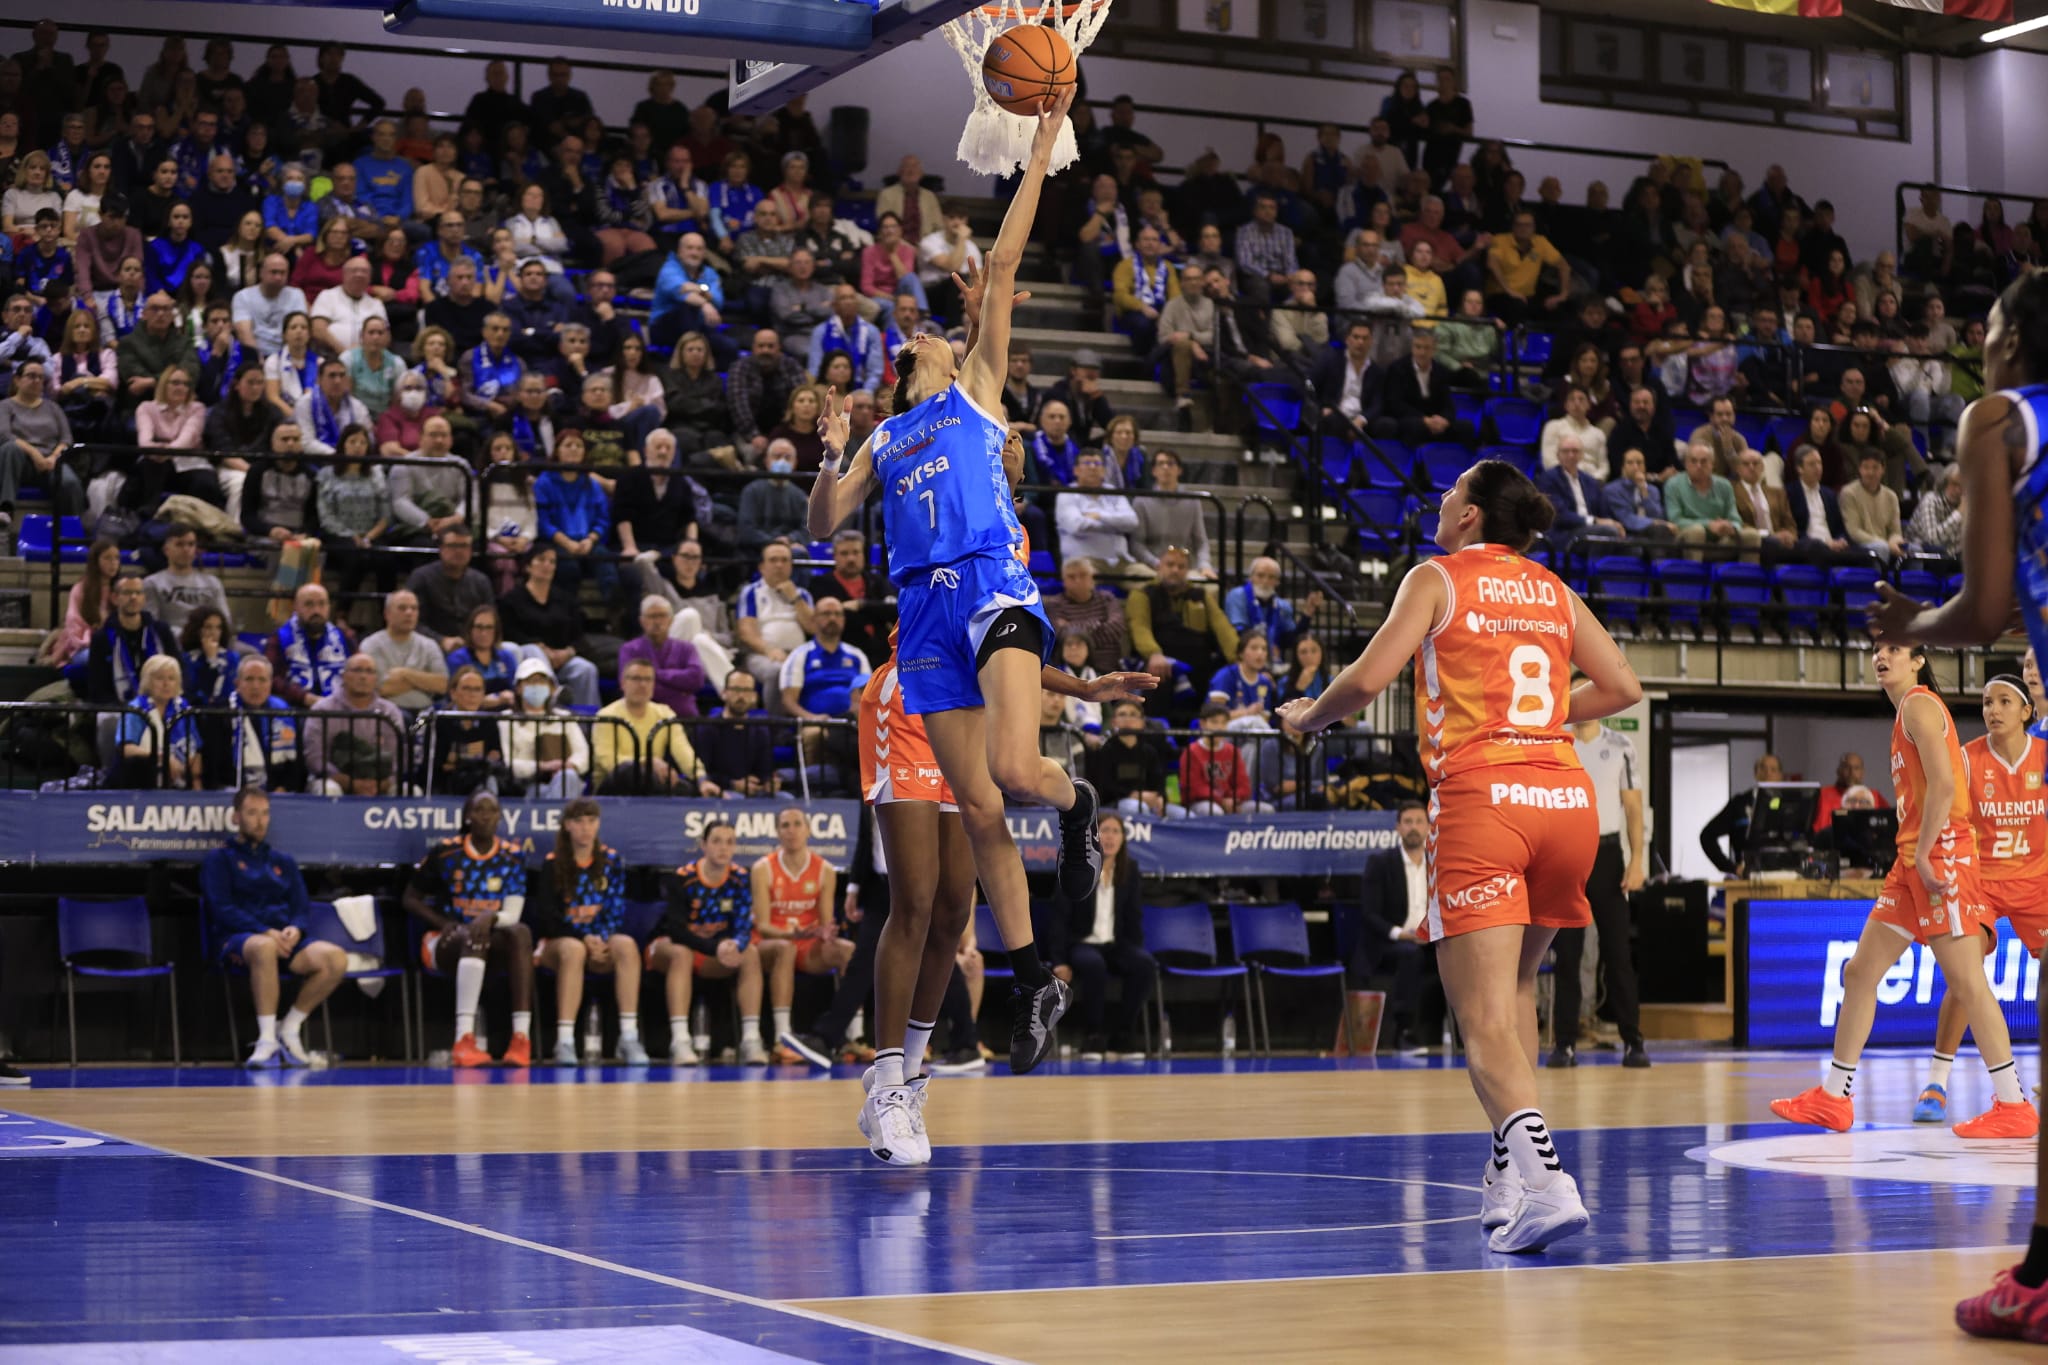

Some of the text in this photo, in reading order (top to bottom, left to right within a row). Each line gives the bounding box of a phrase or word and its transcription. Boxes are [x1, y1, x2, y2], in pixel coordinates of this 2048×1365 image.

[929, 416, 961, 432] LEÓN
[919, 489, 936, 529] 7
[1477, 573, 1557, 607] ARAÚJO
[1507, 644, 1555, 728] 8
[918, 768, 942, 778] PULE
[1490, 783, 1589, 809] PAMESA
[1979, 799, 2045, 817] VALENCIA
[86, 804, 241, 832] SALAMANC
[364, 806, 462, 829] CASTIL
[531, 809, 561, 831] LE
[684, 811, 847, 839] SAMCA
[1995, 817, 2031, 826] BASKET
[1224, 824, 1401, 855] perfumeriasave
[1992, 831, 2031, 858] 24
[1446, 884, 1498, 908] MGS
